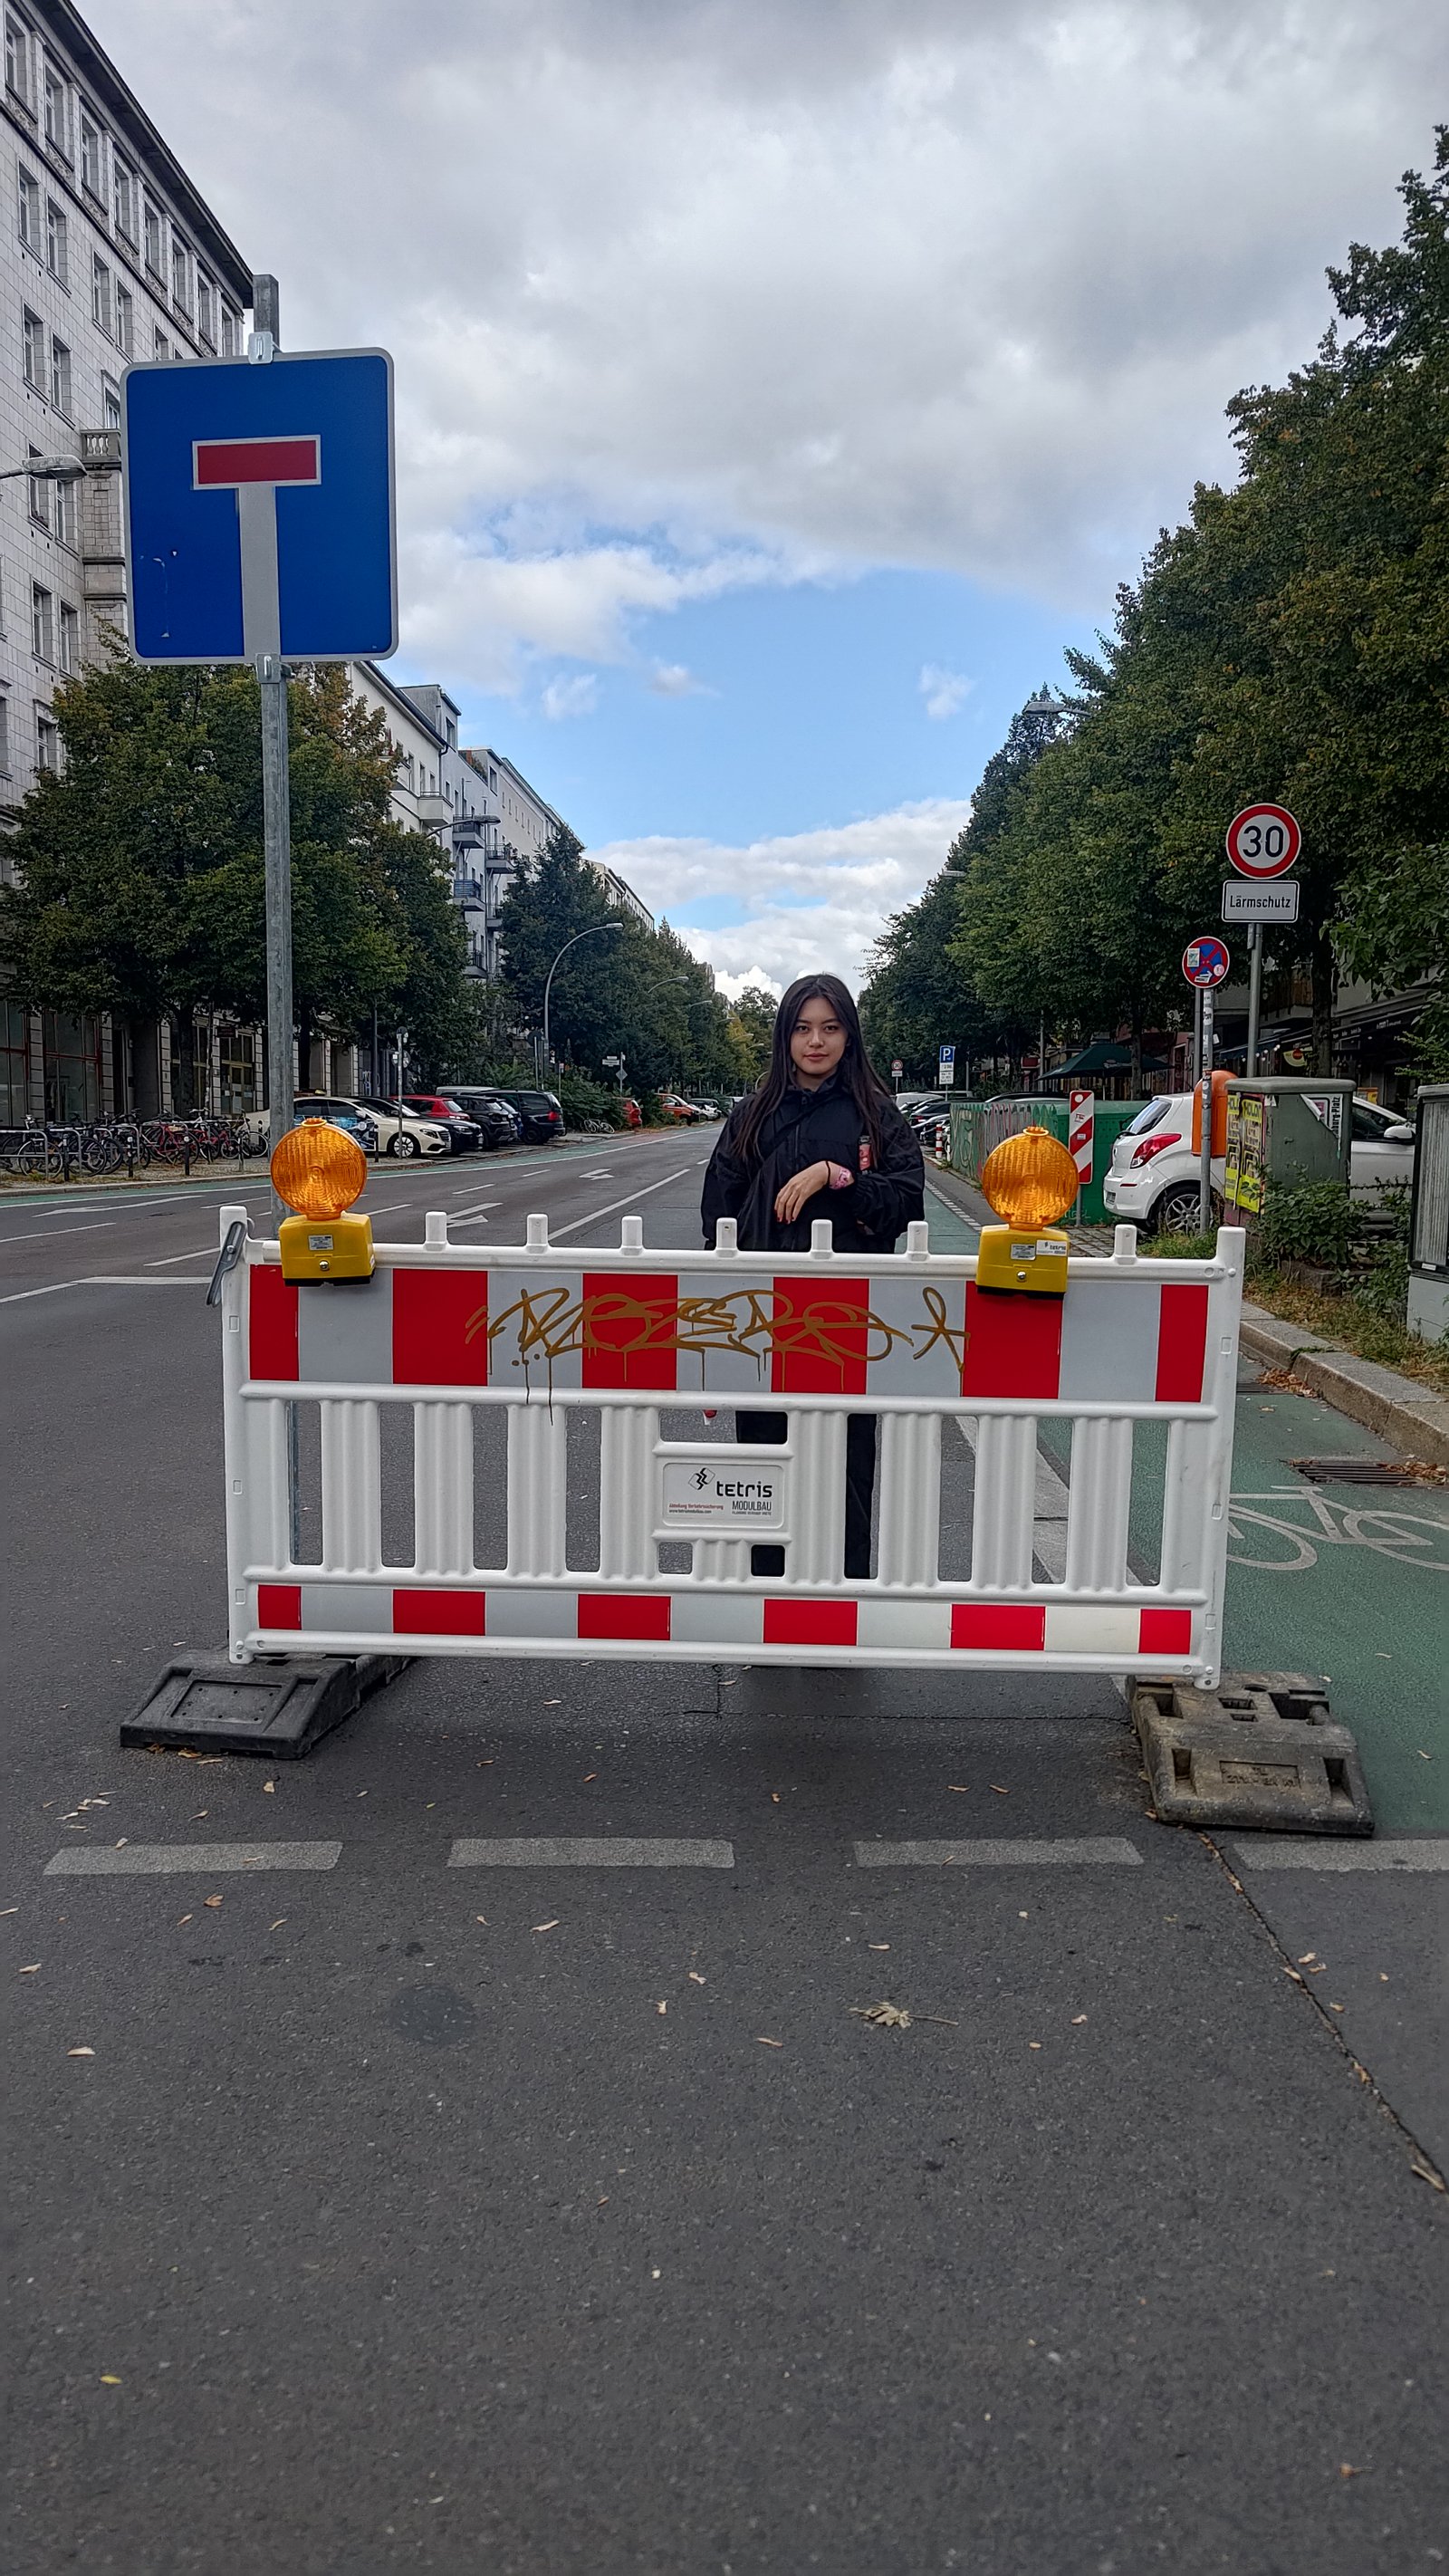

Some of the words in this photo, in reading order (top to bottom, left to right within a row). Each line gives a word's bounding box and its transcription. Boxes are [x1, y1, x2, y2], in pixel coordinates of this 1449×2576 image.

[1243, 825, 1284, 858] 30
[1230, 895, 1291, 908] Lärmschutz
[943, 1048, 951, 1062] P
[716, 1481, 772, 1498] tetris
[732, 1500, 772, 1512] MODULBAU
